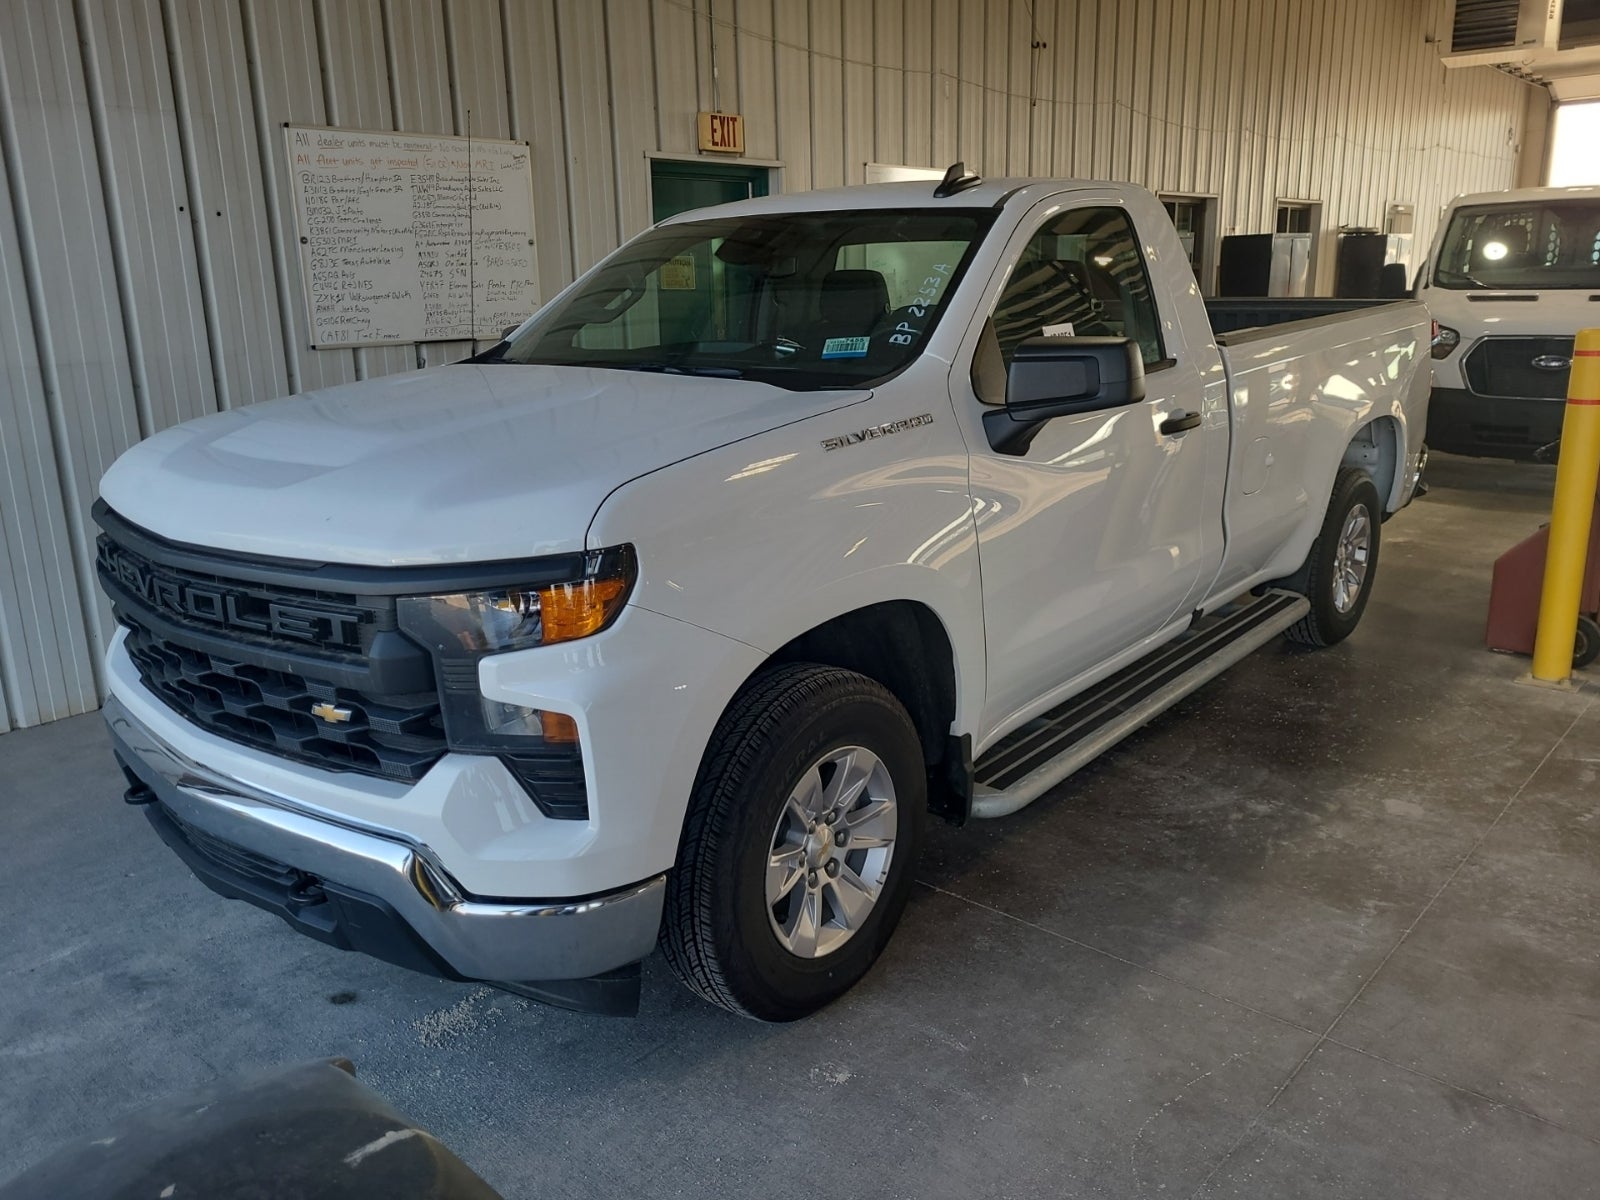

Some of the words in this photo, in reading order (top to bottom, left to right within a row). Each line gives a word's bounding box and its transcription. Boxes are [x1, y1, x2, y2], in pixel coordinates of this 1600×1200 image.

[295, 132, 310, 147] All
[317, 134, 344, 147] dealer
[710, 115, 738, 148] EXIT
[297, 154, 310, 165] All
[889, 321, 922, 345] BP
[820, 413, 934, 452] SILVERADO
[97, 538, 372, 648] CHEVROLET
